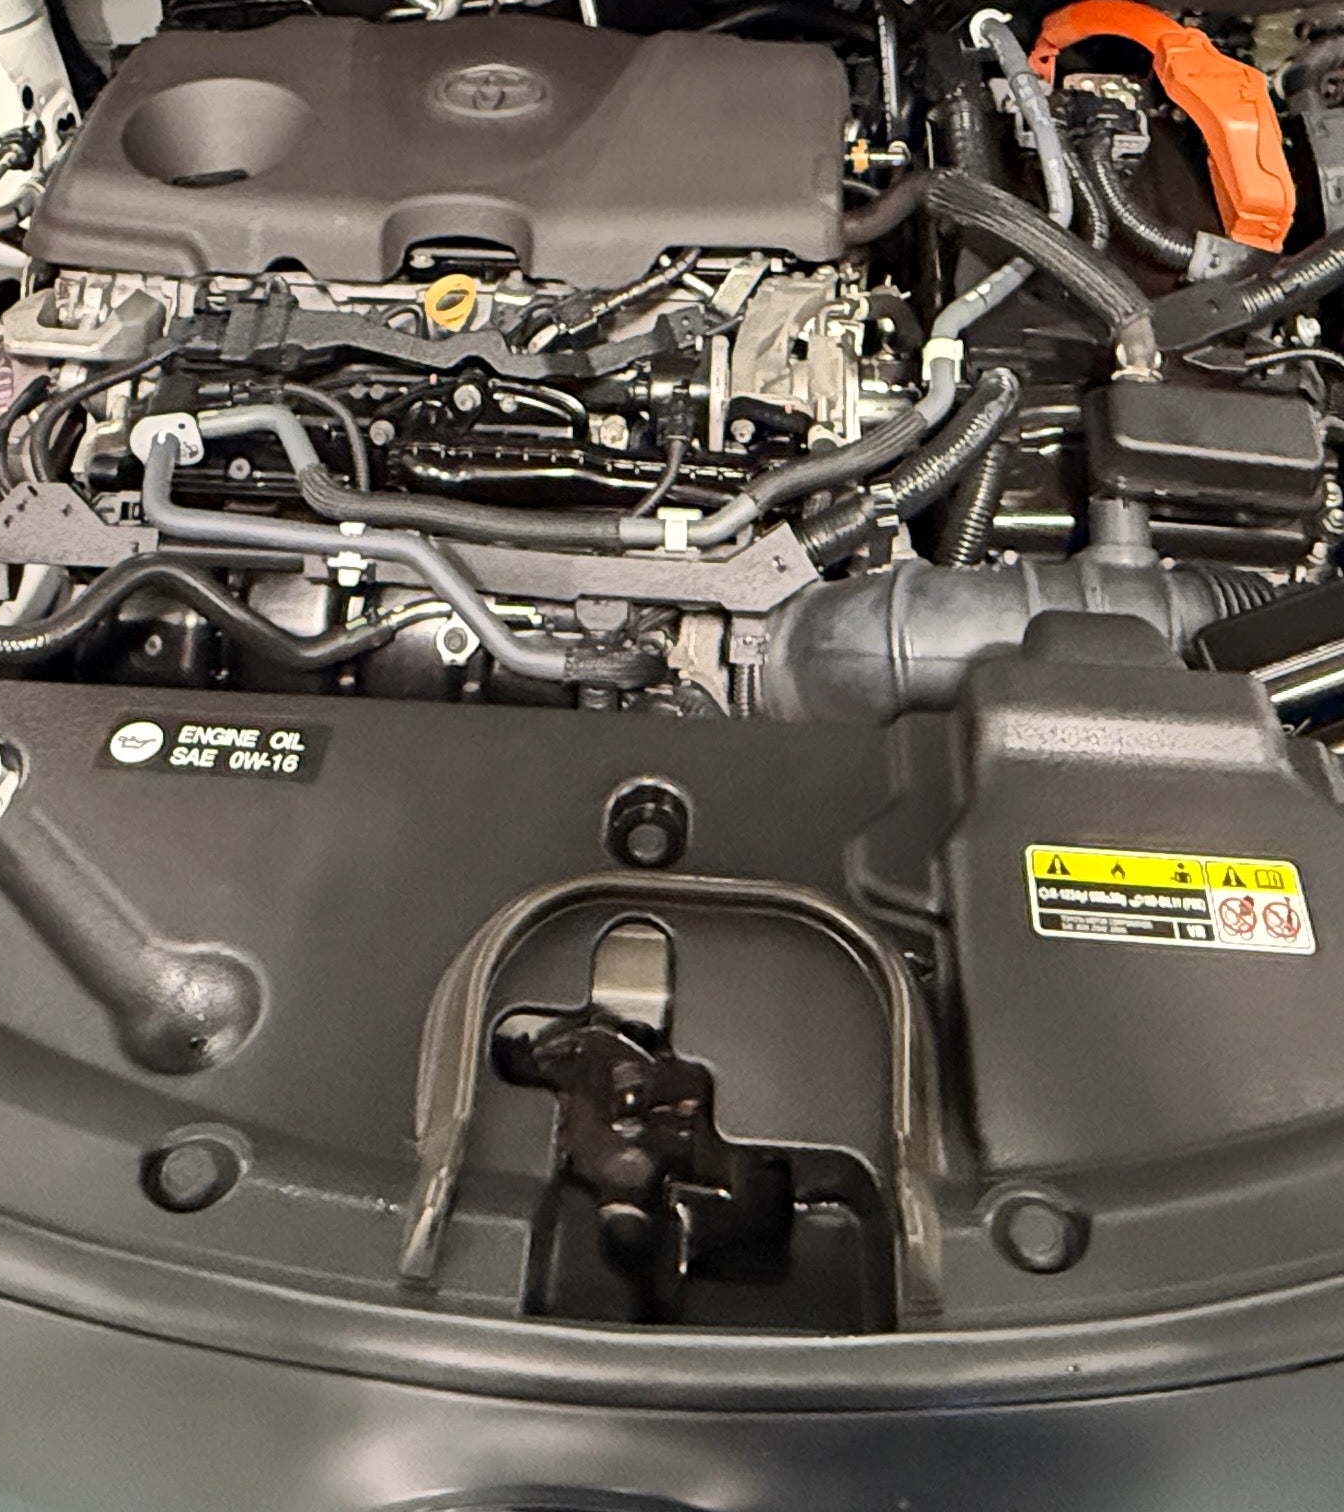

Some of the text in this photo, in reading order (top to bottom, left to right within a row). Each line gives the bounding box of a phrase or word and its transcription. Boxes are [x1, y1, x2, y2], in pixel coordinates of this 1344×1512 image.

[178, 725, 306, 751] ENGINE OIL
[169, 746, 300, 773] SAE 0W-16
